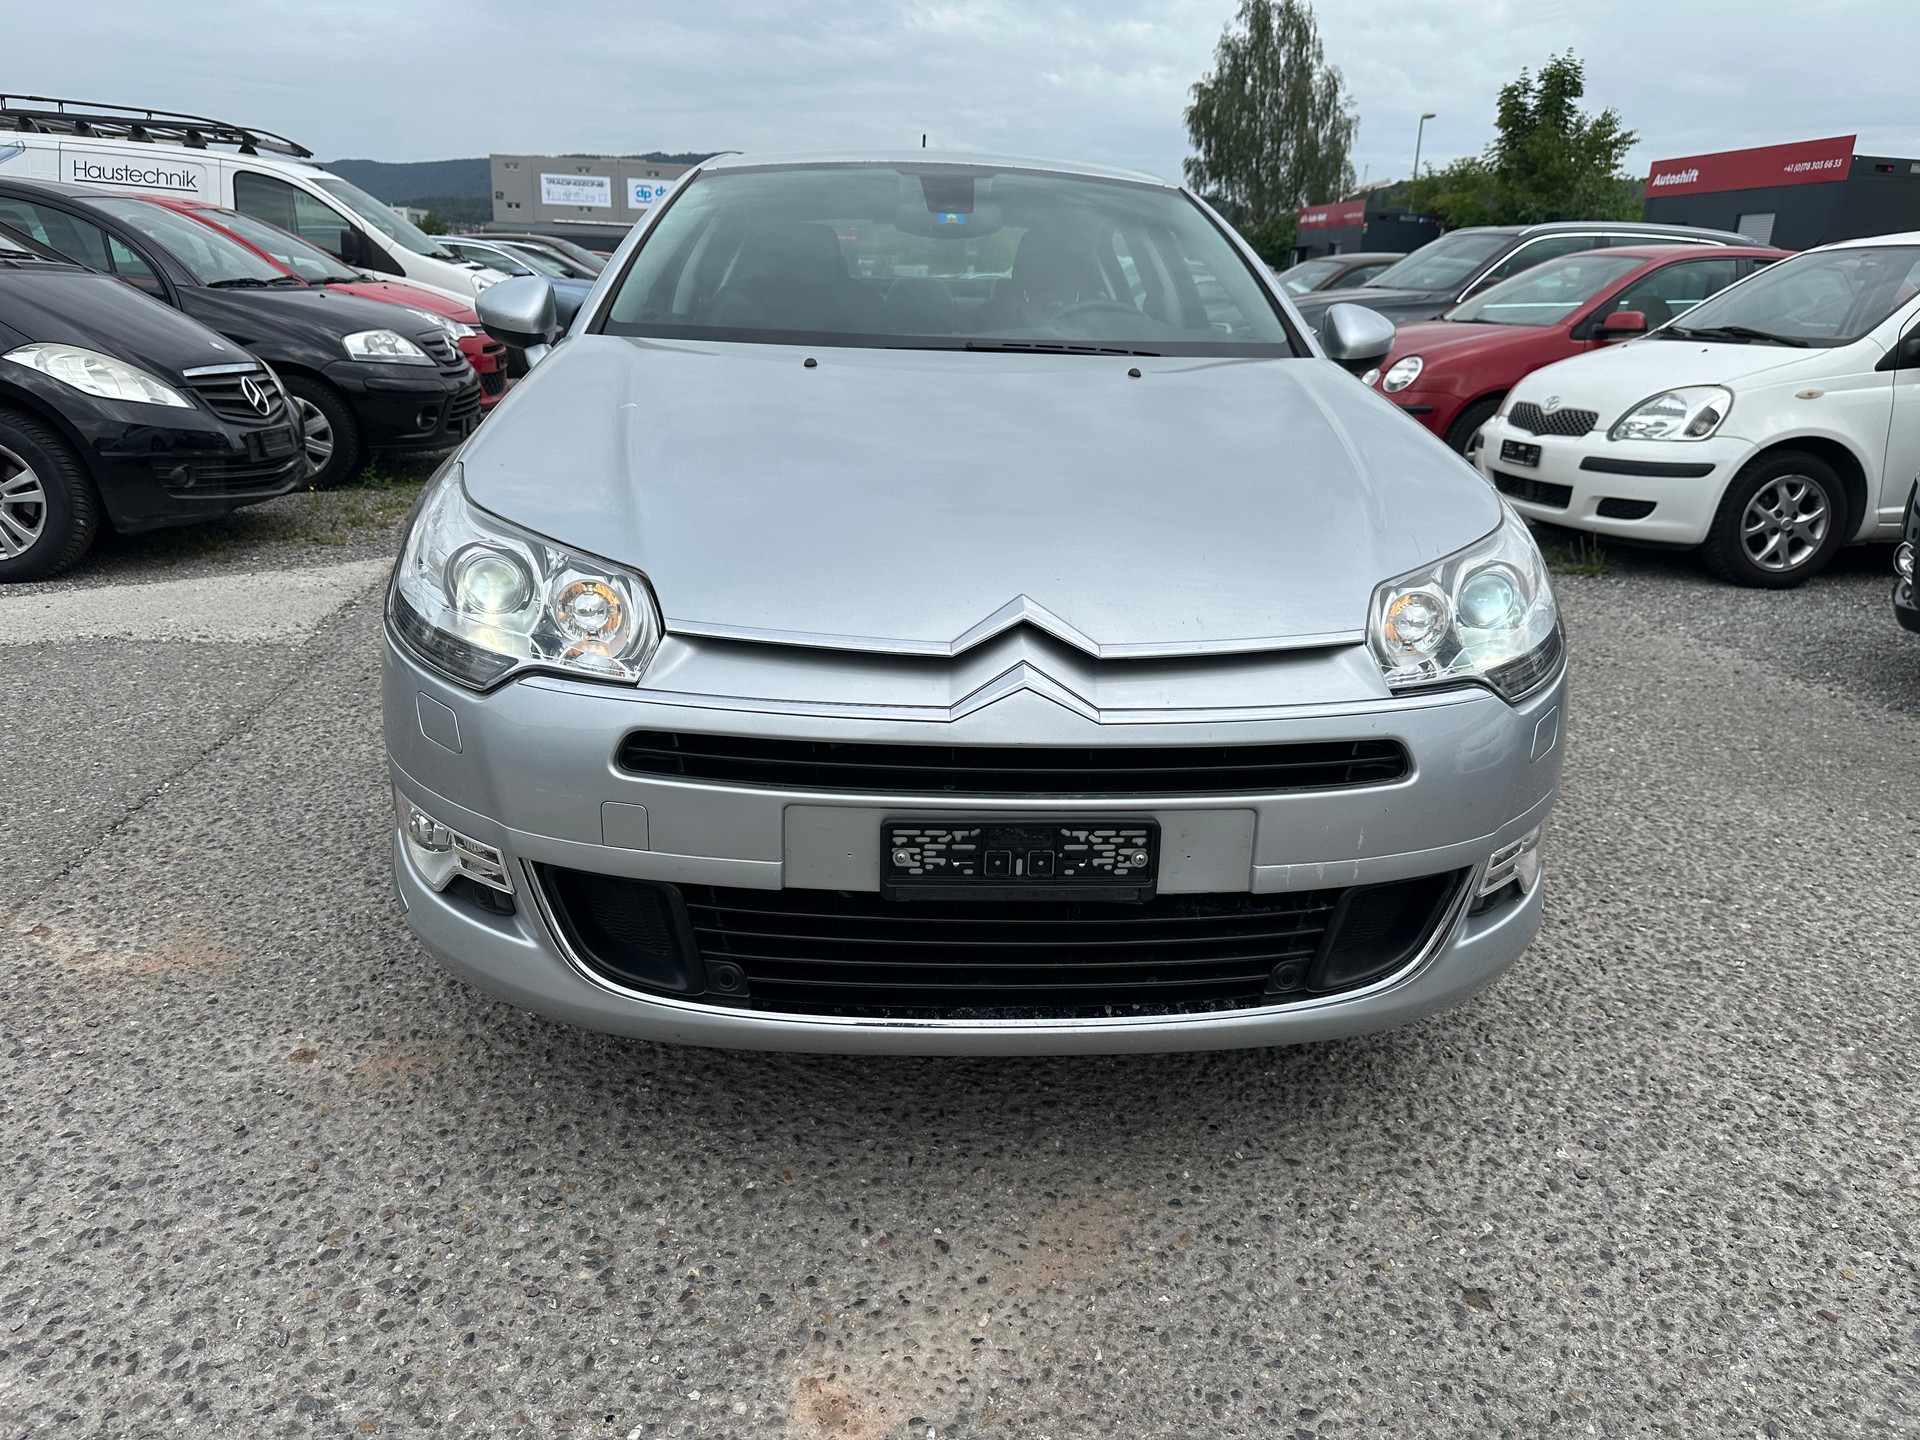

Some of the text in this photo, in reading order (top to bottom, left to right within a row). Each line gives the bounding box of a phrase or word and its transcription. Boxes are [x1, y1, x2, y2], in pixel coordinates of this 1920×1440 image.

[1824, 159, 1834, 169] 66
[74, 159, 197, 188] Haustechnik
[1652, 168, 1699, 187] Autoshift
[636, 186, 652, 201] dp
